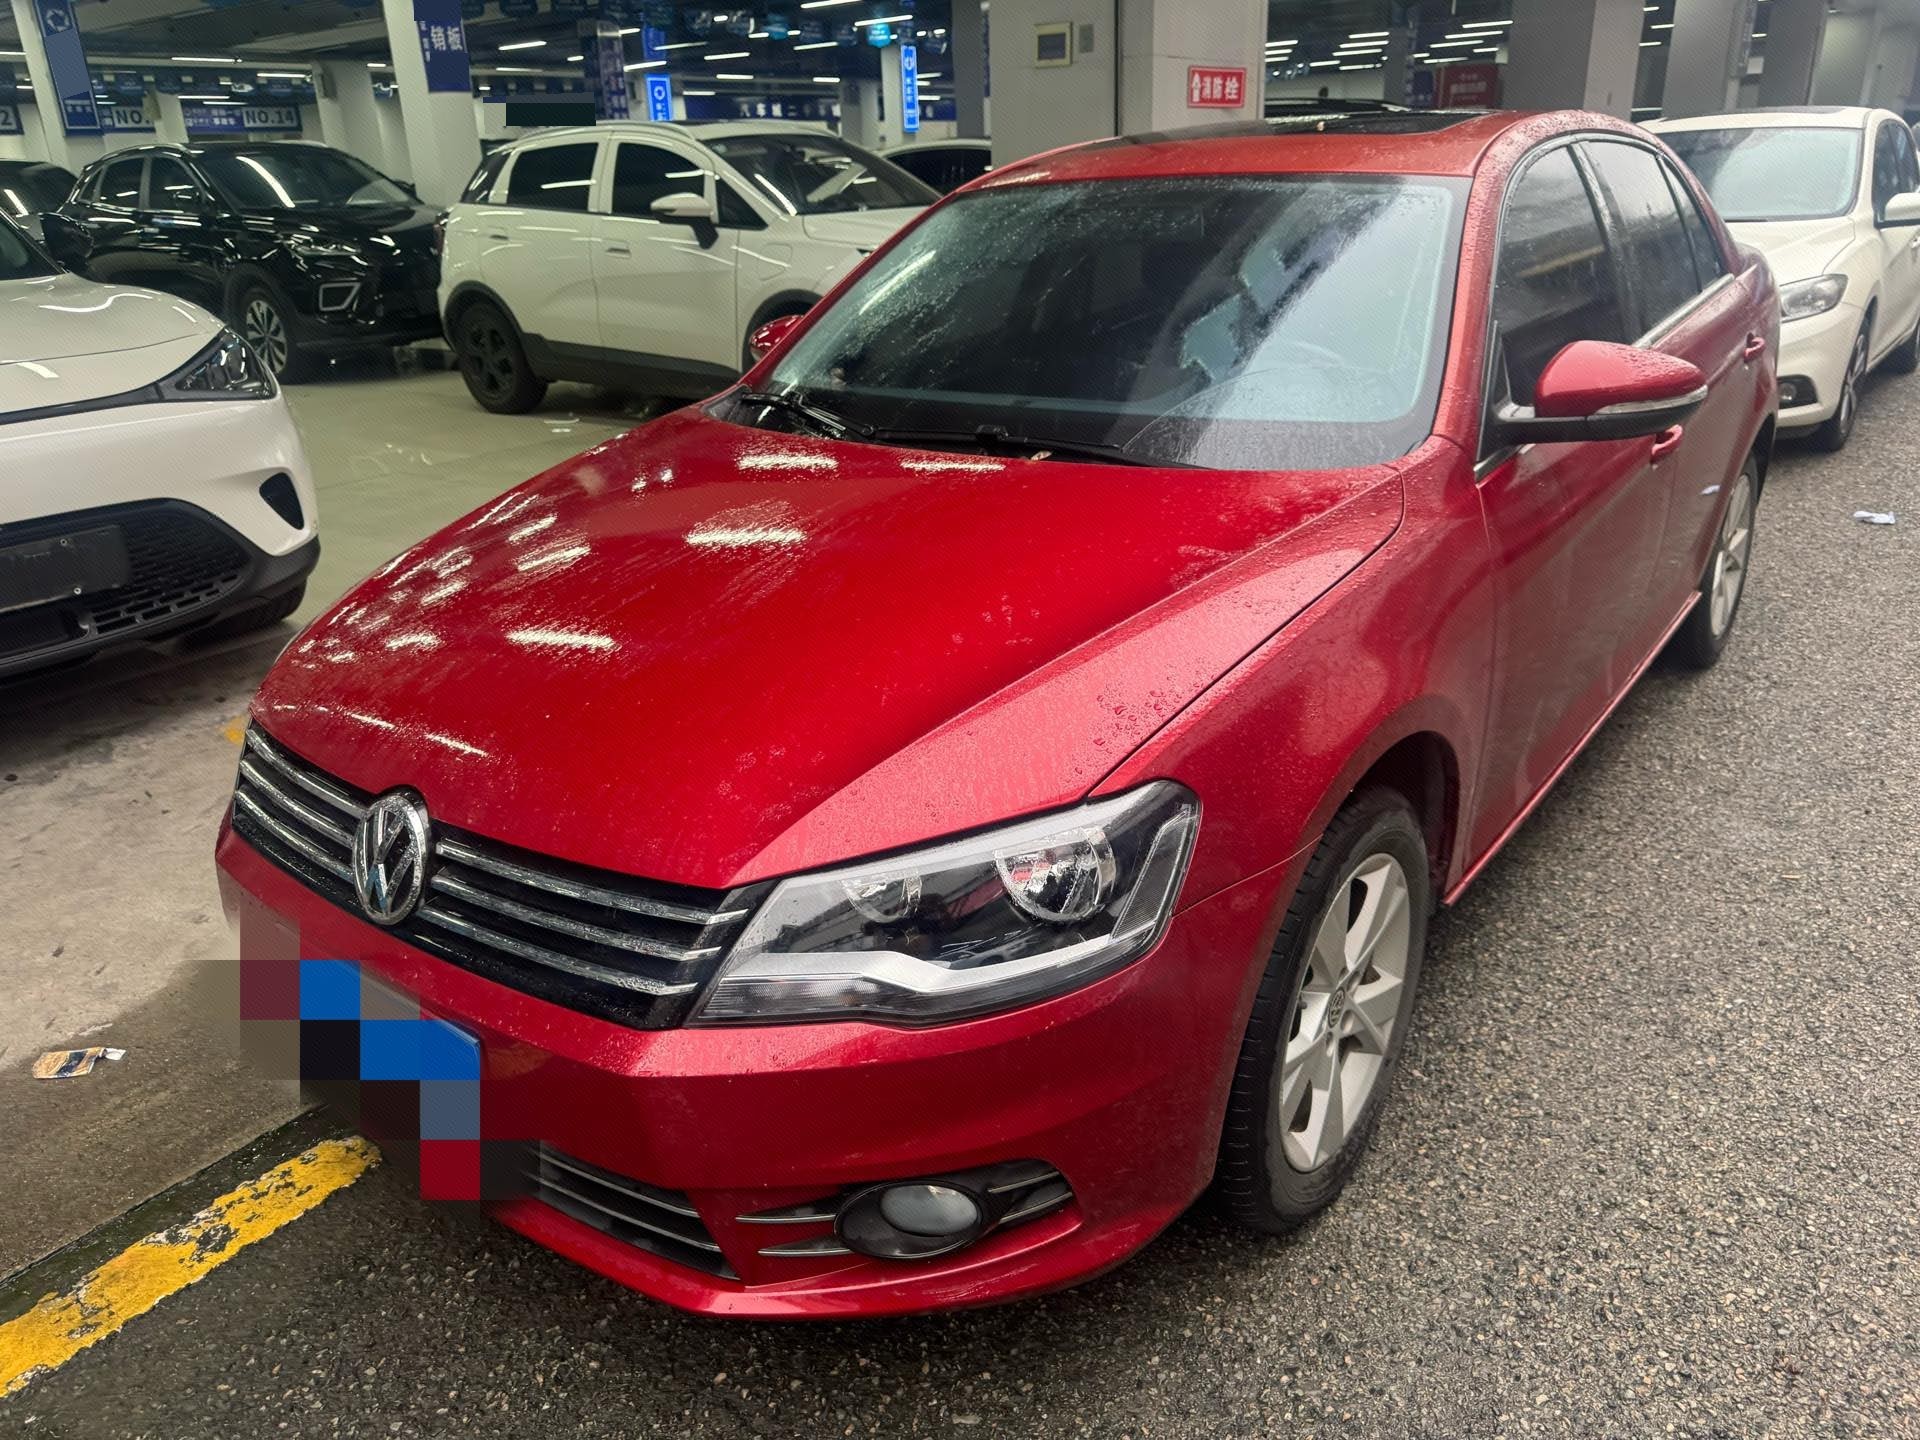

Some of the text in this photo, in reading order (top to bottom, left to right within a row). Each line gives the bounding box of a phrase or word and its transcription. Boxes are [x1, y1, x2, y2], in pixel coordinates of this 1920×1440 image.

[1201, 76, 1240, 101] 消防栓
[245, 109, 295, 125] NO.14
